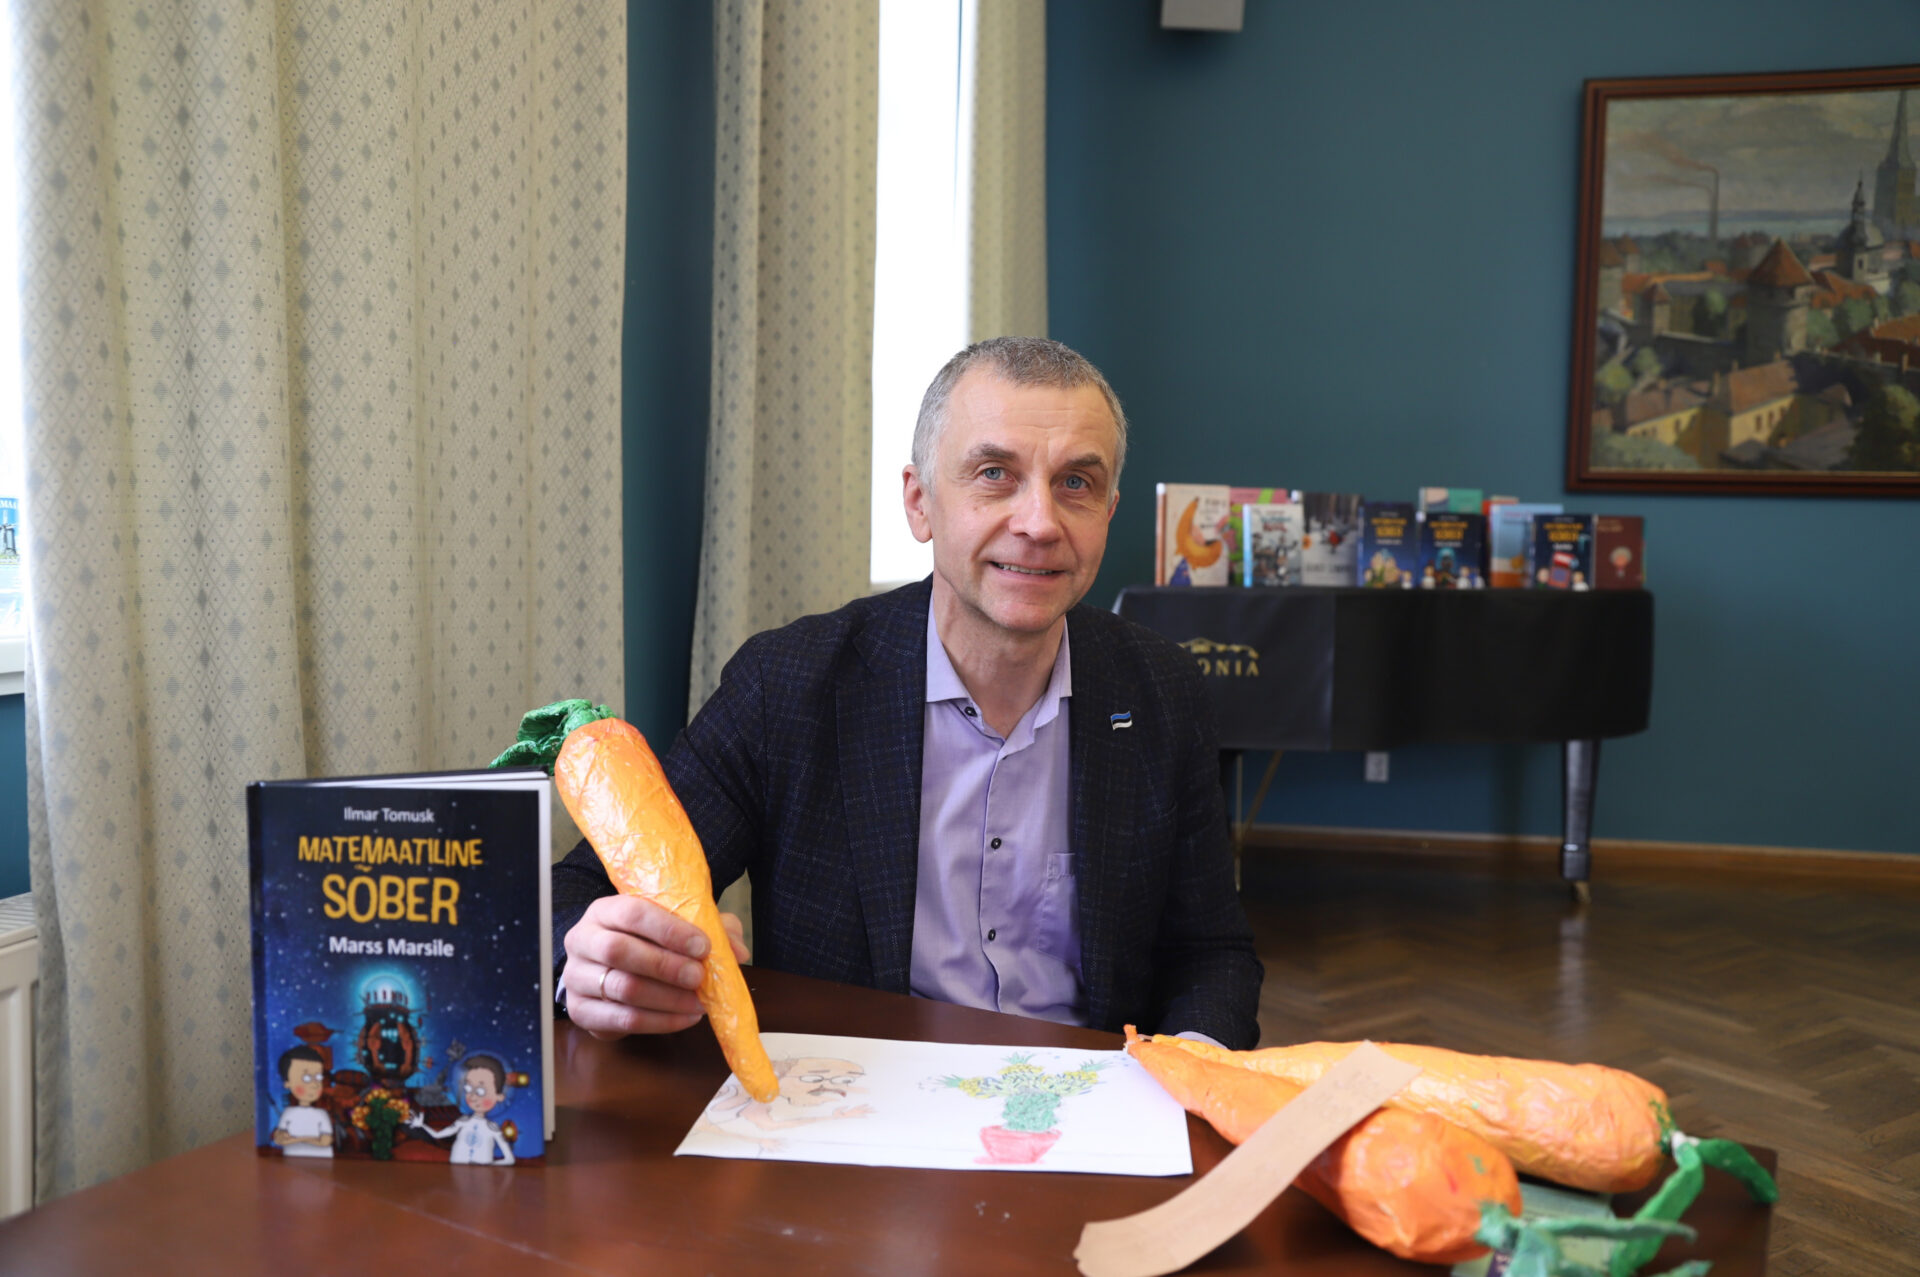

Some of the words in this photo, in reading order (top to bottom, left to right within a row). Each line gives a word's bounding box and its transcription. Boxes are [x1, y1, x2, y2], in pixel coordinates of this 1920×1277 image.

[343, 806, 379, 821] Ilmar
[382, 808, 434, 823] Tomusk
[298, 836, 483, 866] MATEMAATILINE
[323, 865, 460, 925] SÕBER
[329, 936, 383, 955] Marss
[387, 938, 455, 957] Marsile
